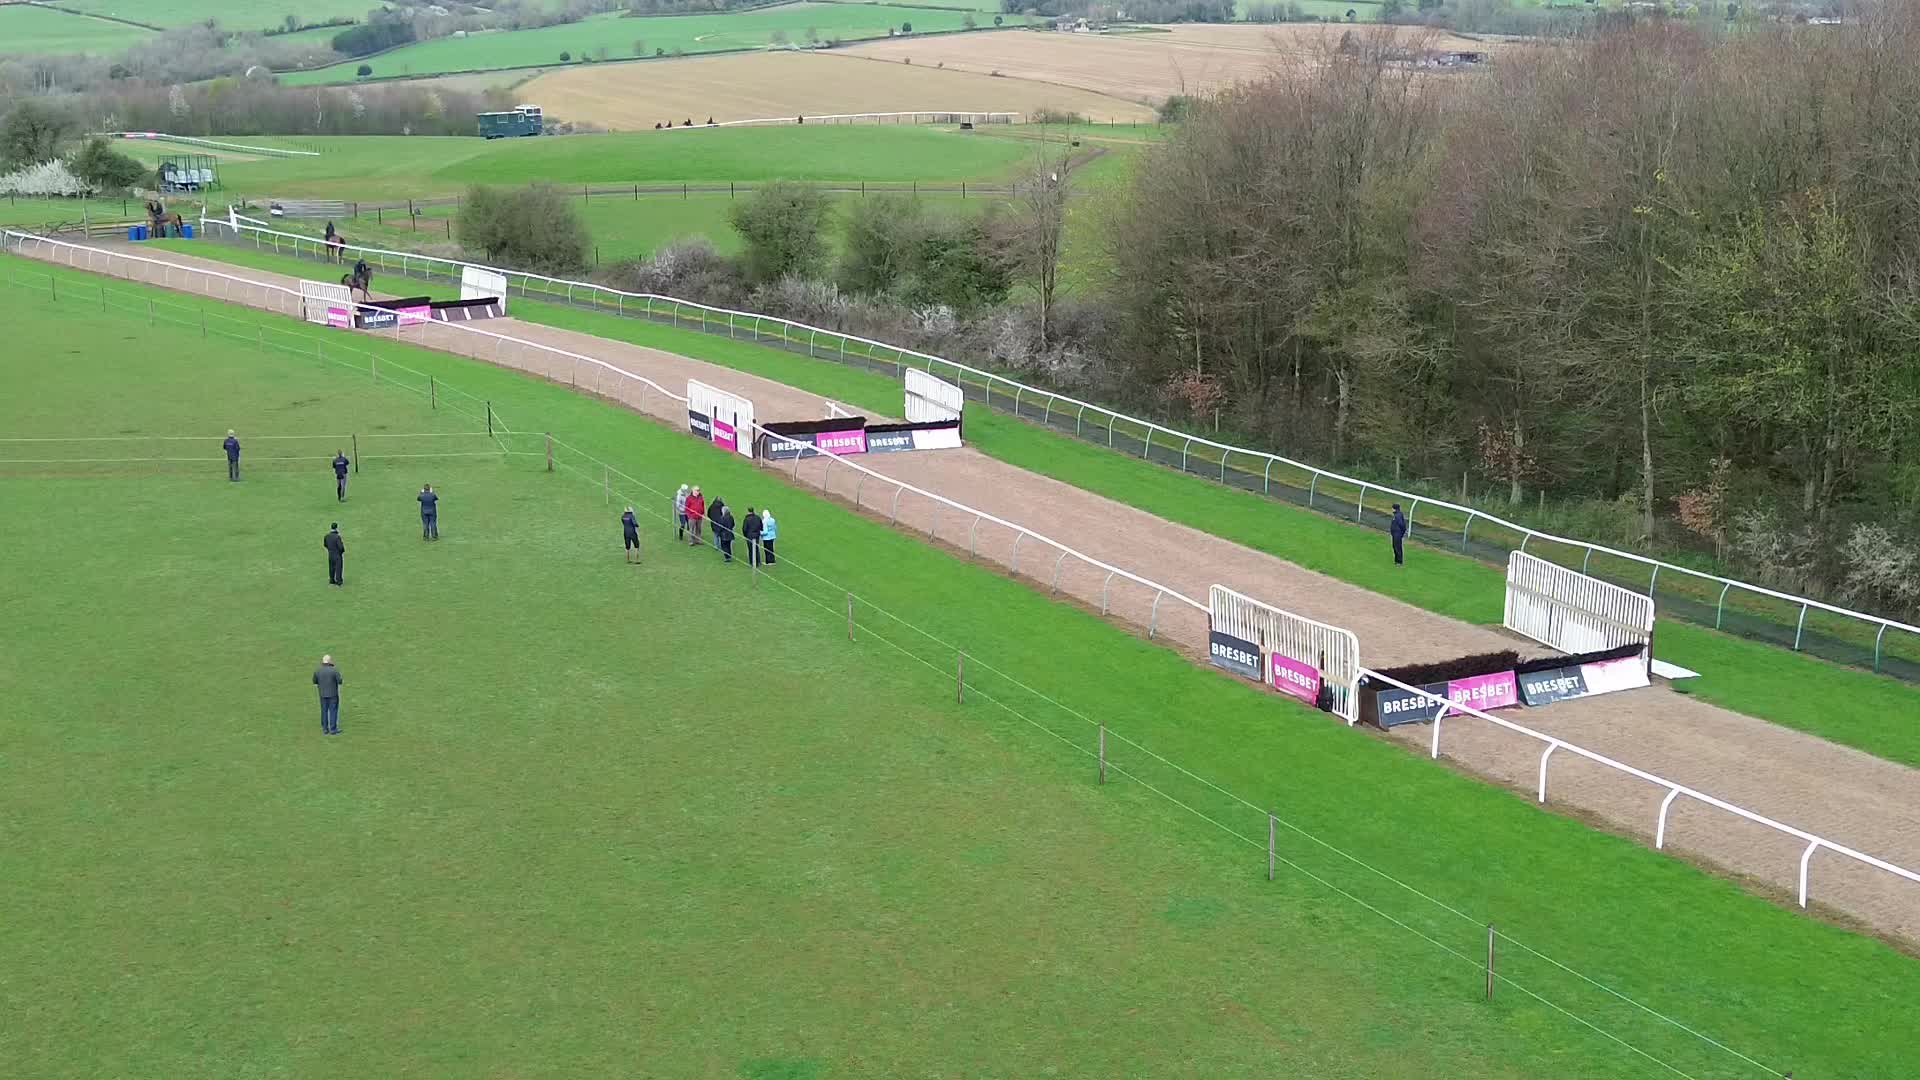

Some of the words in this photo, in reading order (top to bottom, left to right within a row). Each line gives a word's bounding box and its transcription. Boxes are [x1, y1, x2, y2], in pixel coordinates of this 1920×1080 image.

[1211, 642, 1259, 668] BRESBET
[1274, 663, 1318, 690] BRESBET
[1526, 676, 1580, 695] BRESBET
[1454, 682, 1512, 703] BRESBET
